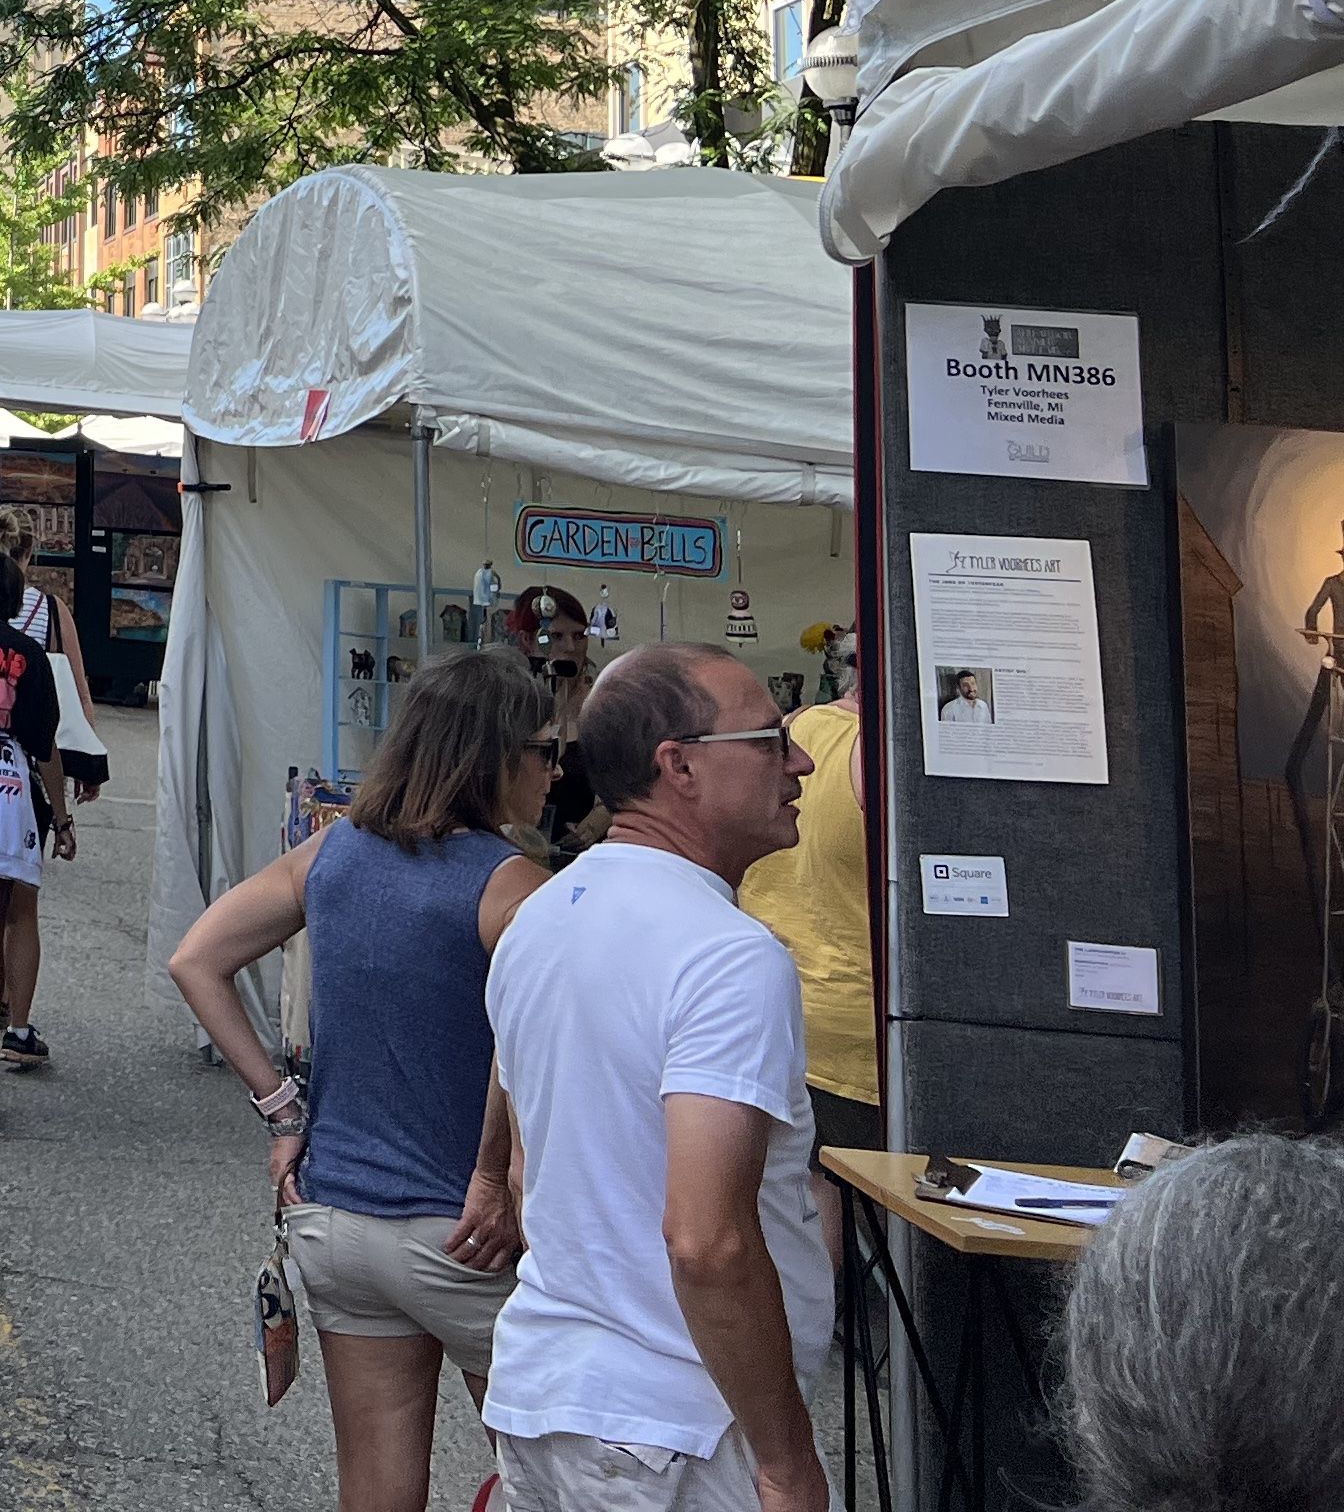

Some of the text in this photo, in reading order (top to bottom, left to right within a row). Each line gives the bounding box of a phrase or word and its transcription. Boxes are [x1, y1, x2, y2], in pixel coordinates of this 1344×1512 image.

[946, 358, 1116, 386] Booth MN386
[980, 385, 1069, 400] Tyler Voorhees
[987, 399, 1064, 412] Fennville, MI
[987, 411, 1065, 425] Mixed Media
[527, 519, 708, 565] GARDEN BELLS
[1044, 559, 1062, 574] ART
[951, 867, 992, 880] Square
